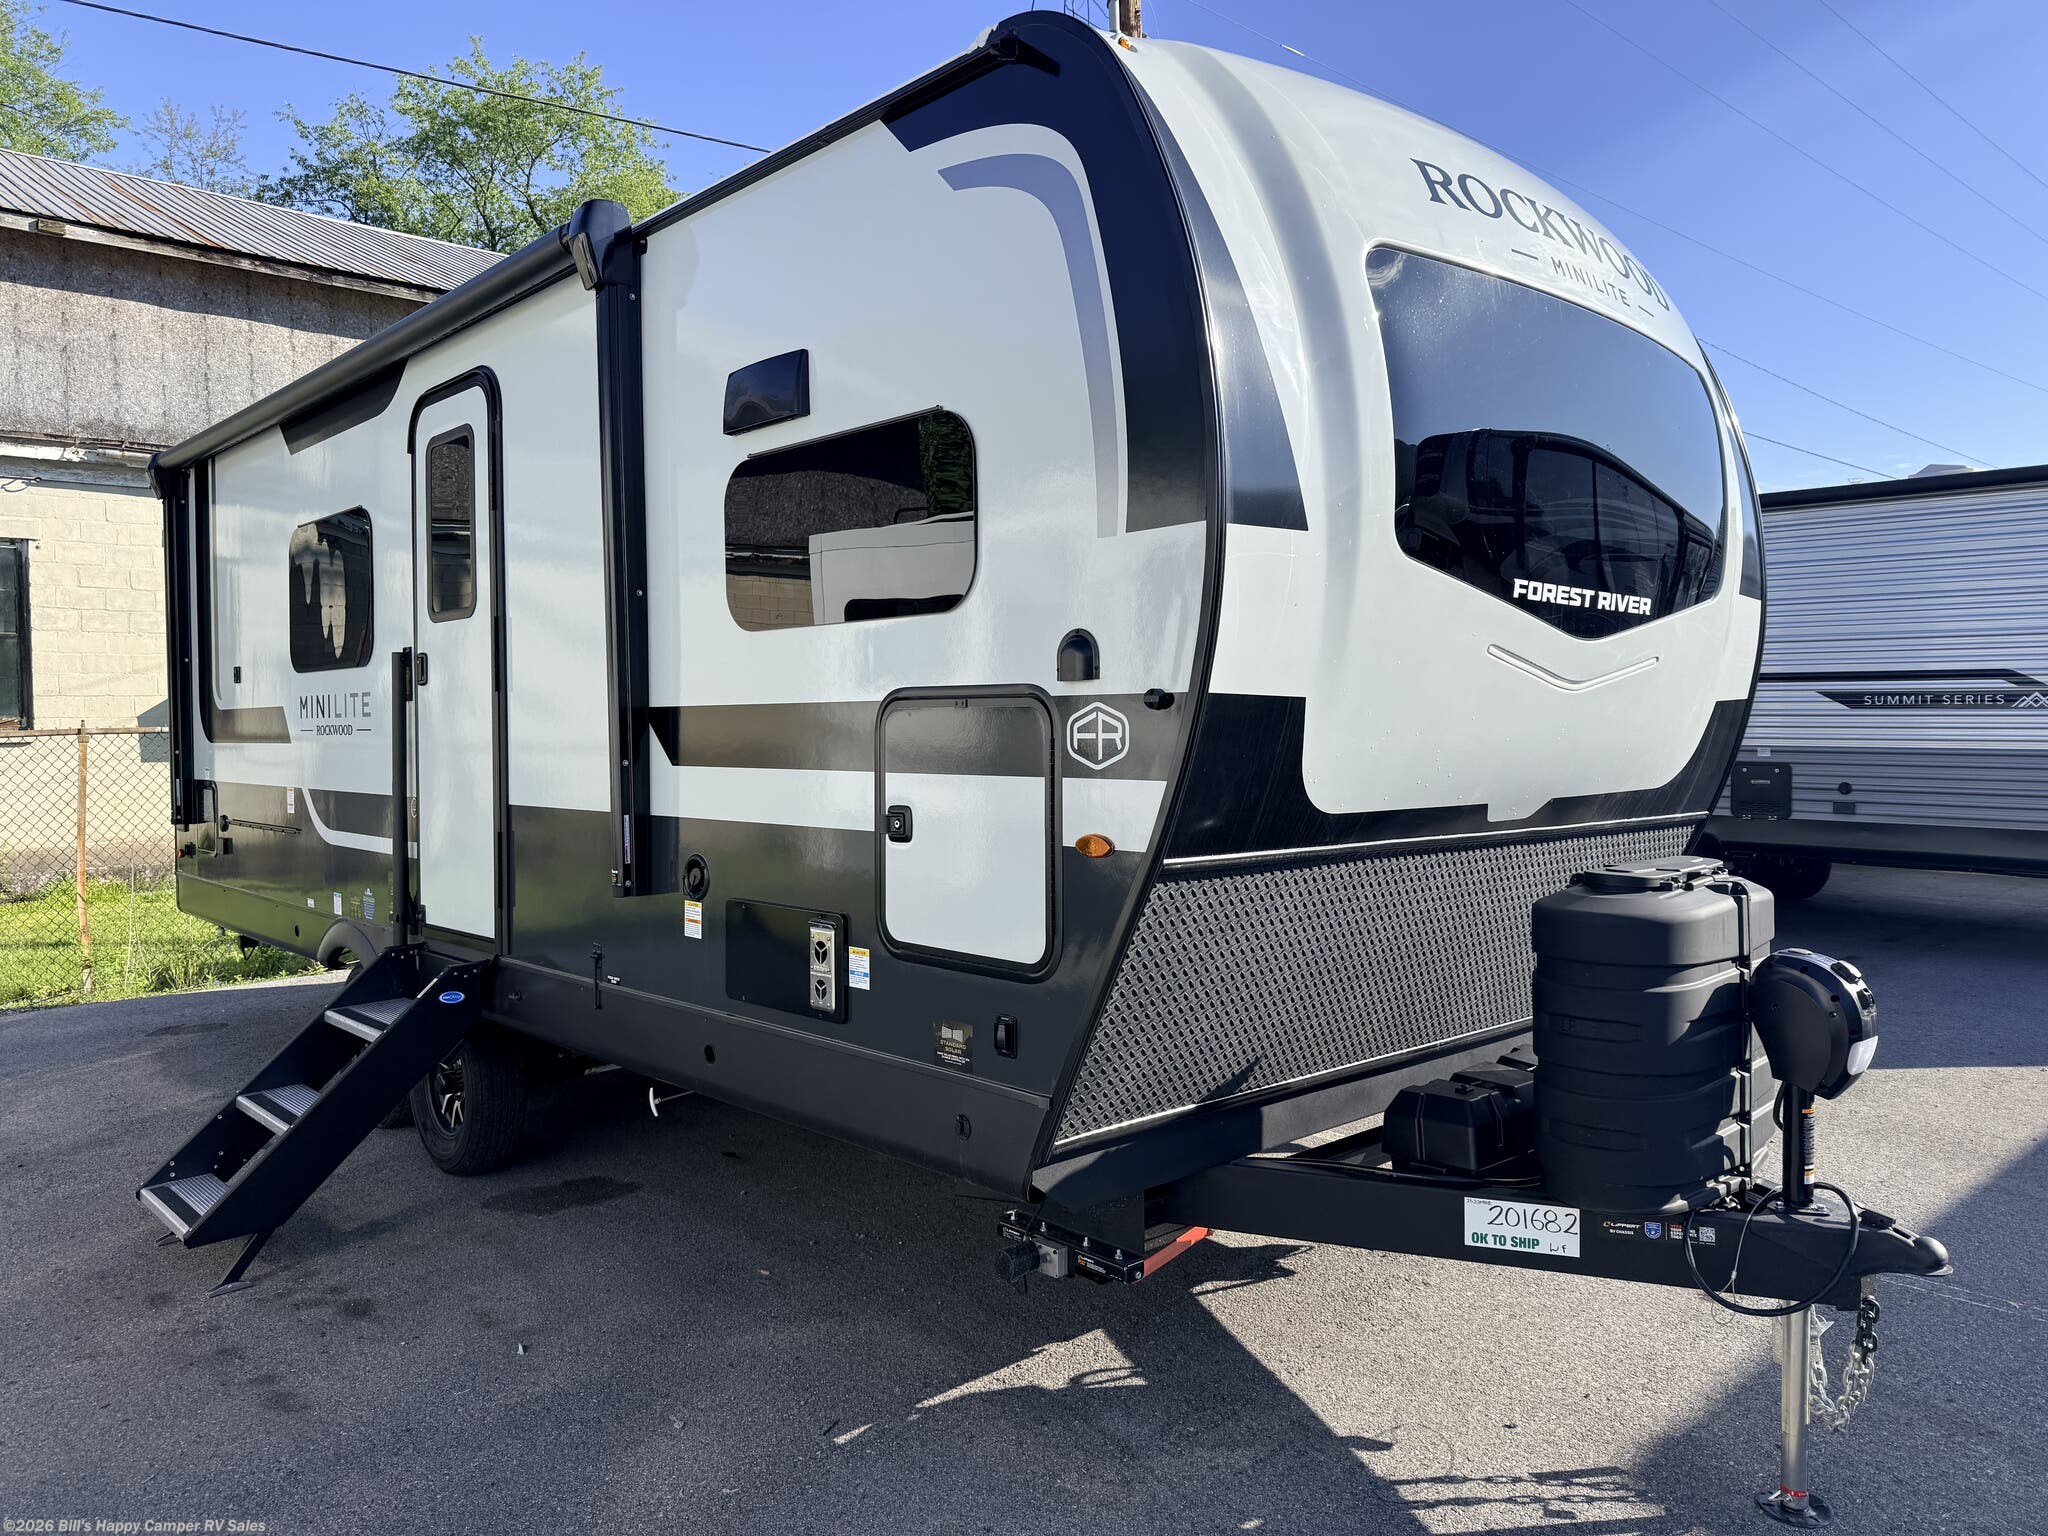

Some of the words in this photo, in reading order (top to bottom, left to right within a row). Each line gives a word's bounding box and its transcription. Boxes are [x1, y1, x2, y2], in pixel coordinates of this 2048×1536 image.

[1410, 158, 1670, 312] ROCKWOOD
[1551, 256, 1631, 307] MINILITE
[1513, 578, 1595, 608] FOREST
[1597, 591, 1652, 616] RIVER
[299, 691, 372, 719] MINILITE
[1864, 694, 1934, 706] SUMMIT
[1942, 694, 2006, 705] SERIES
[316, 724, 353, 736] ROCKWOOD
[1487, 1204, 1579, 1236] 201682
[1471, 1231, 1488, 1245] OK
[1491, 1233, 1507, 1247] TO
[1510, 1235, 1540, 1251] SHIP
